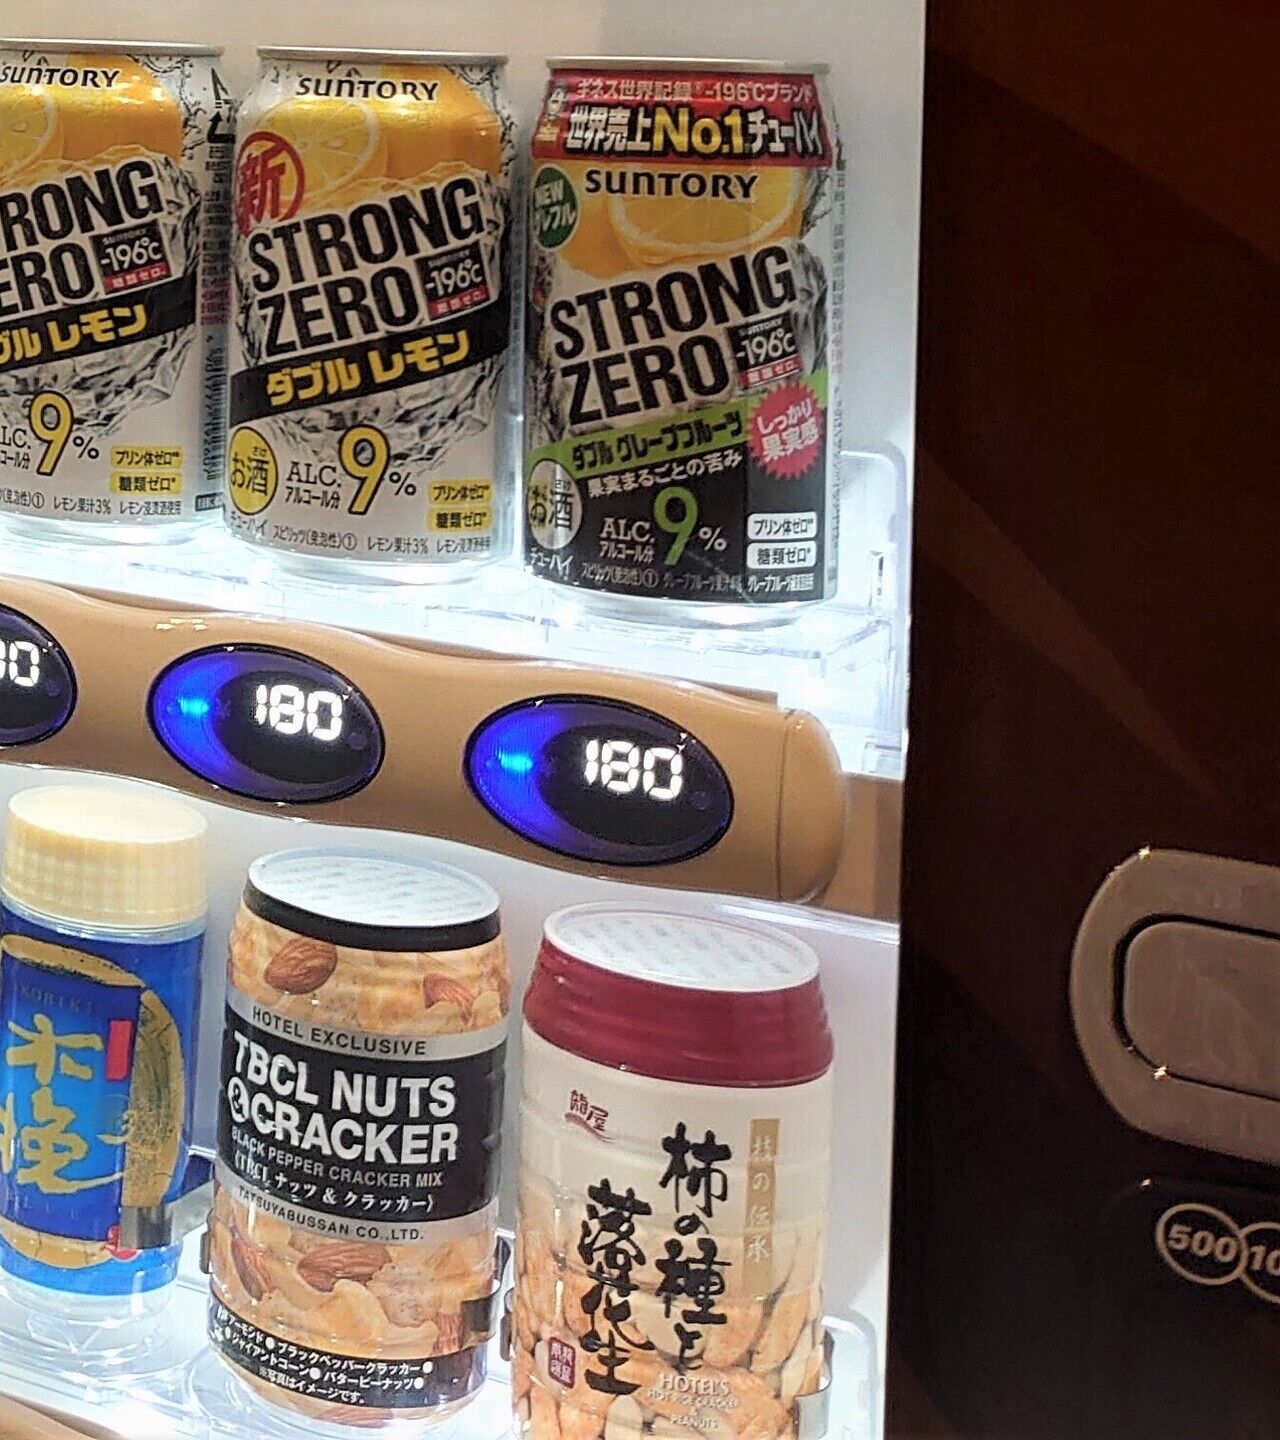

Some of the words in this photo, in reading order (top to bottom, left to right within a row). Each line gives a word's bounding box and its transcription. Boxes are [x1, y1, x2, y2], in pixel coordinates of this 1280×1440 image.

[248, 177, 484, 293] STRONG
[47, 303, 149, 353] レモン
[257, 266, 419, 358] ZERO
[550, 245, 797, 361] STRONG
[266, 357, 362, 407] ダブル
[367, 329, 470, 384] レモン
[561, 334, 730, 426] ZERO
[616, 412, 743, 463] グレープフルーツ
[756, 399, 812, 435] しっかり
[285, 486, 341, 511] アルコール分
[286, 461, 342, 489] ALC.
[587, 449, 743, 497] 果実まるごとの苦み
[598, 541, 655, 564] アルコール分
[599, 516, 656, 545] ALC.
[254, 683, 344, 743] 180
[583, 739, 683, 801] 180
[252, 1005, 304, 1039] HOTEL
[310, 1027, 427, 1056] EXCLUSIVE
[233, 1030, 320, 1106] TBCL
[331, 1068, 457, 1119] NUTS
[250, 1091, 460, 1166] CRACKER
[231, 1124, 267, 1159] BLACK
[268, 1148, 325, 1178] PEPPER
[328, 1164, 411, 1189] CRACKER
[415, 1171, 444, 1189] MIX
[238, 1184, 350, 1236] TATSUYABUSSAN
[273, 1172, 318, 1198] ナッツ
[322, 1187, 338, 1205] &
[1166, 1223, 1239, 1264] 500
